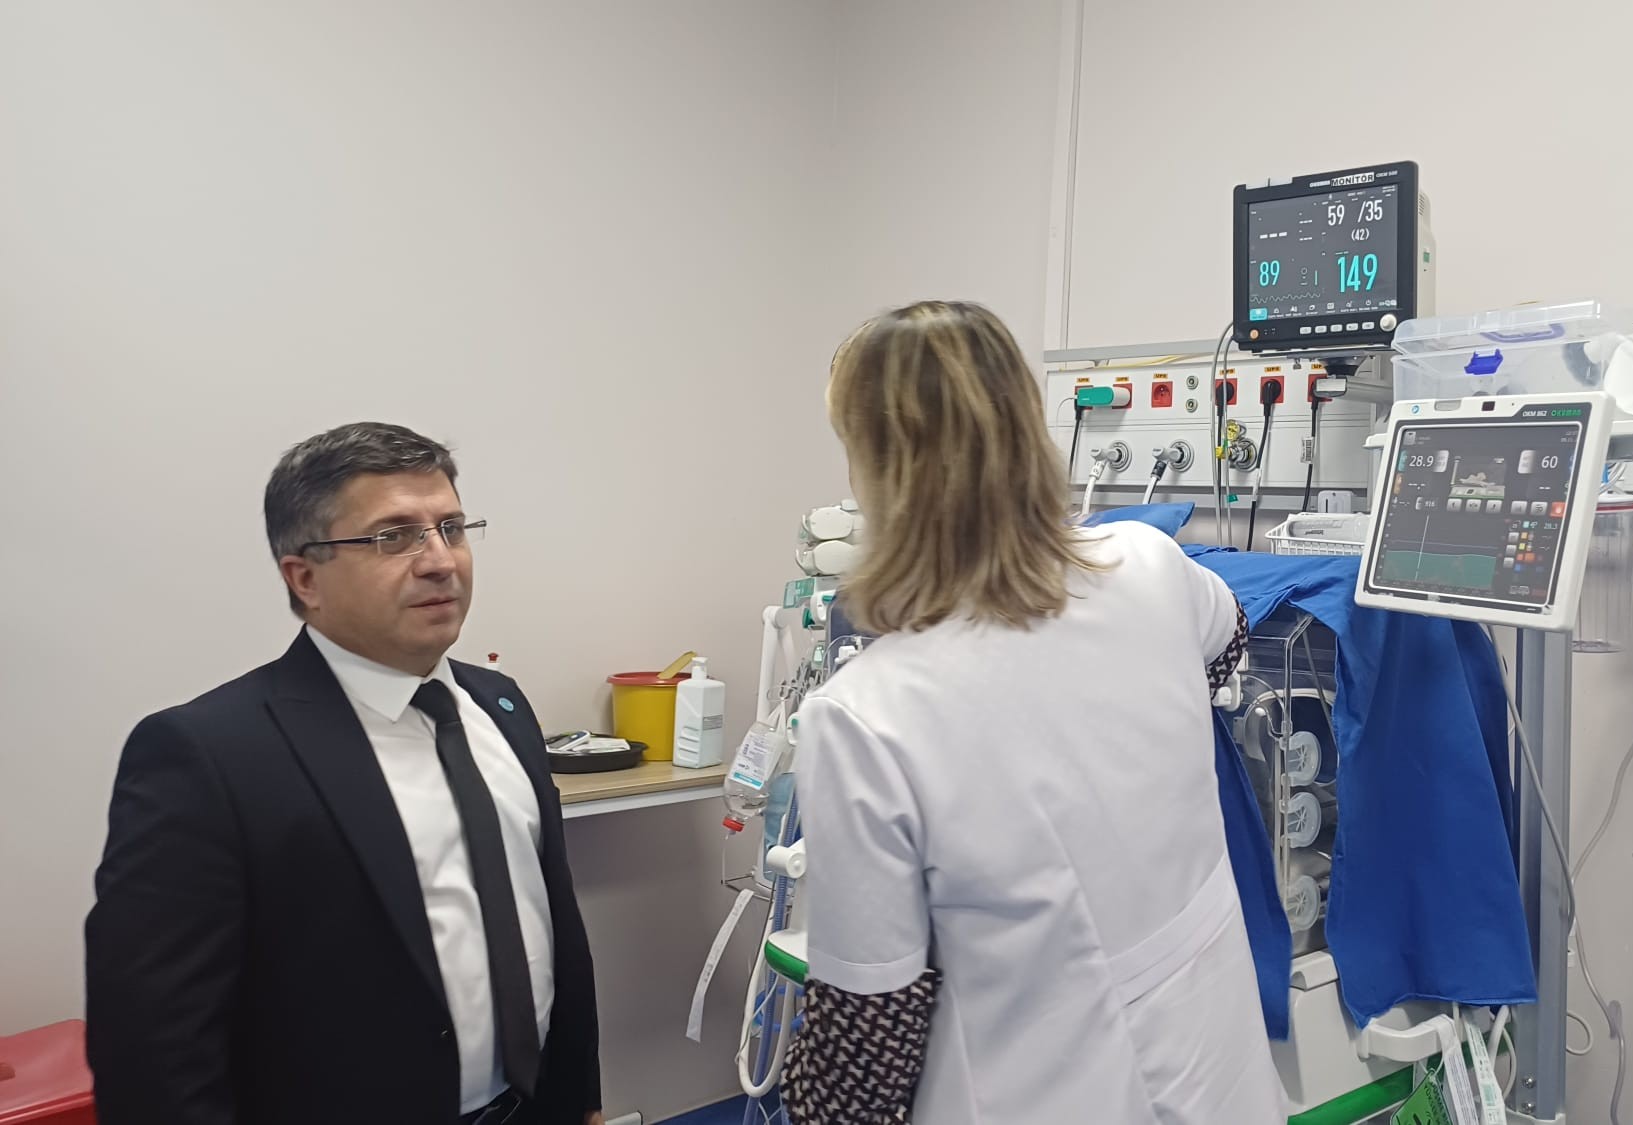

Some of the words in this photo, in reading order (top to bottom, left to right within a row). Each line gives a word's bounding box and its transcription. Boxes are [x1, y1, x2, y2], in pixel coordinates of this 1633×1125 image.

[1328, 205, 1345, 226] 59
[1358, 199, 1383, 223] /35
[1351, 228, 1370, 241] (42)
[1260, 260, 1280, 286] 89
[1338, 253, 1378, 293] 149
[1409, 455, 1434, 467] 28.9
[1541, 455, 1558, 469] 60
